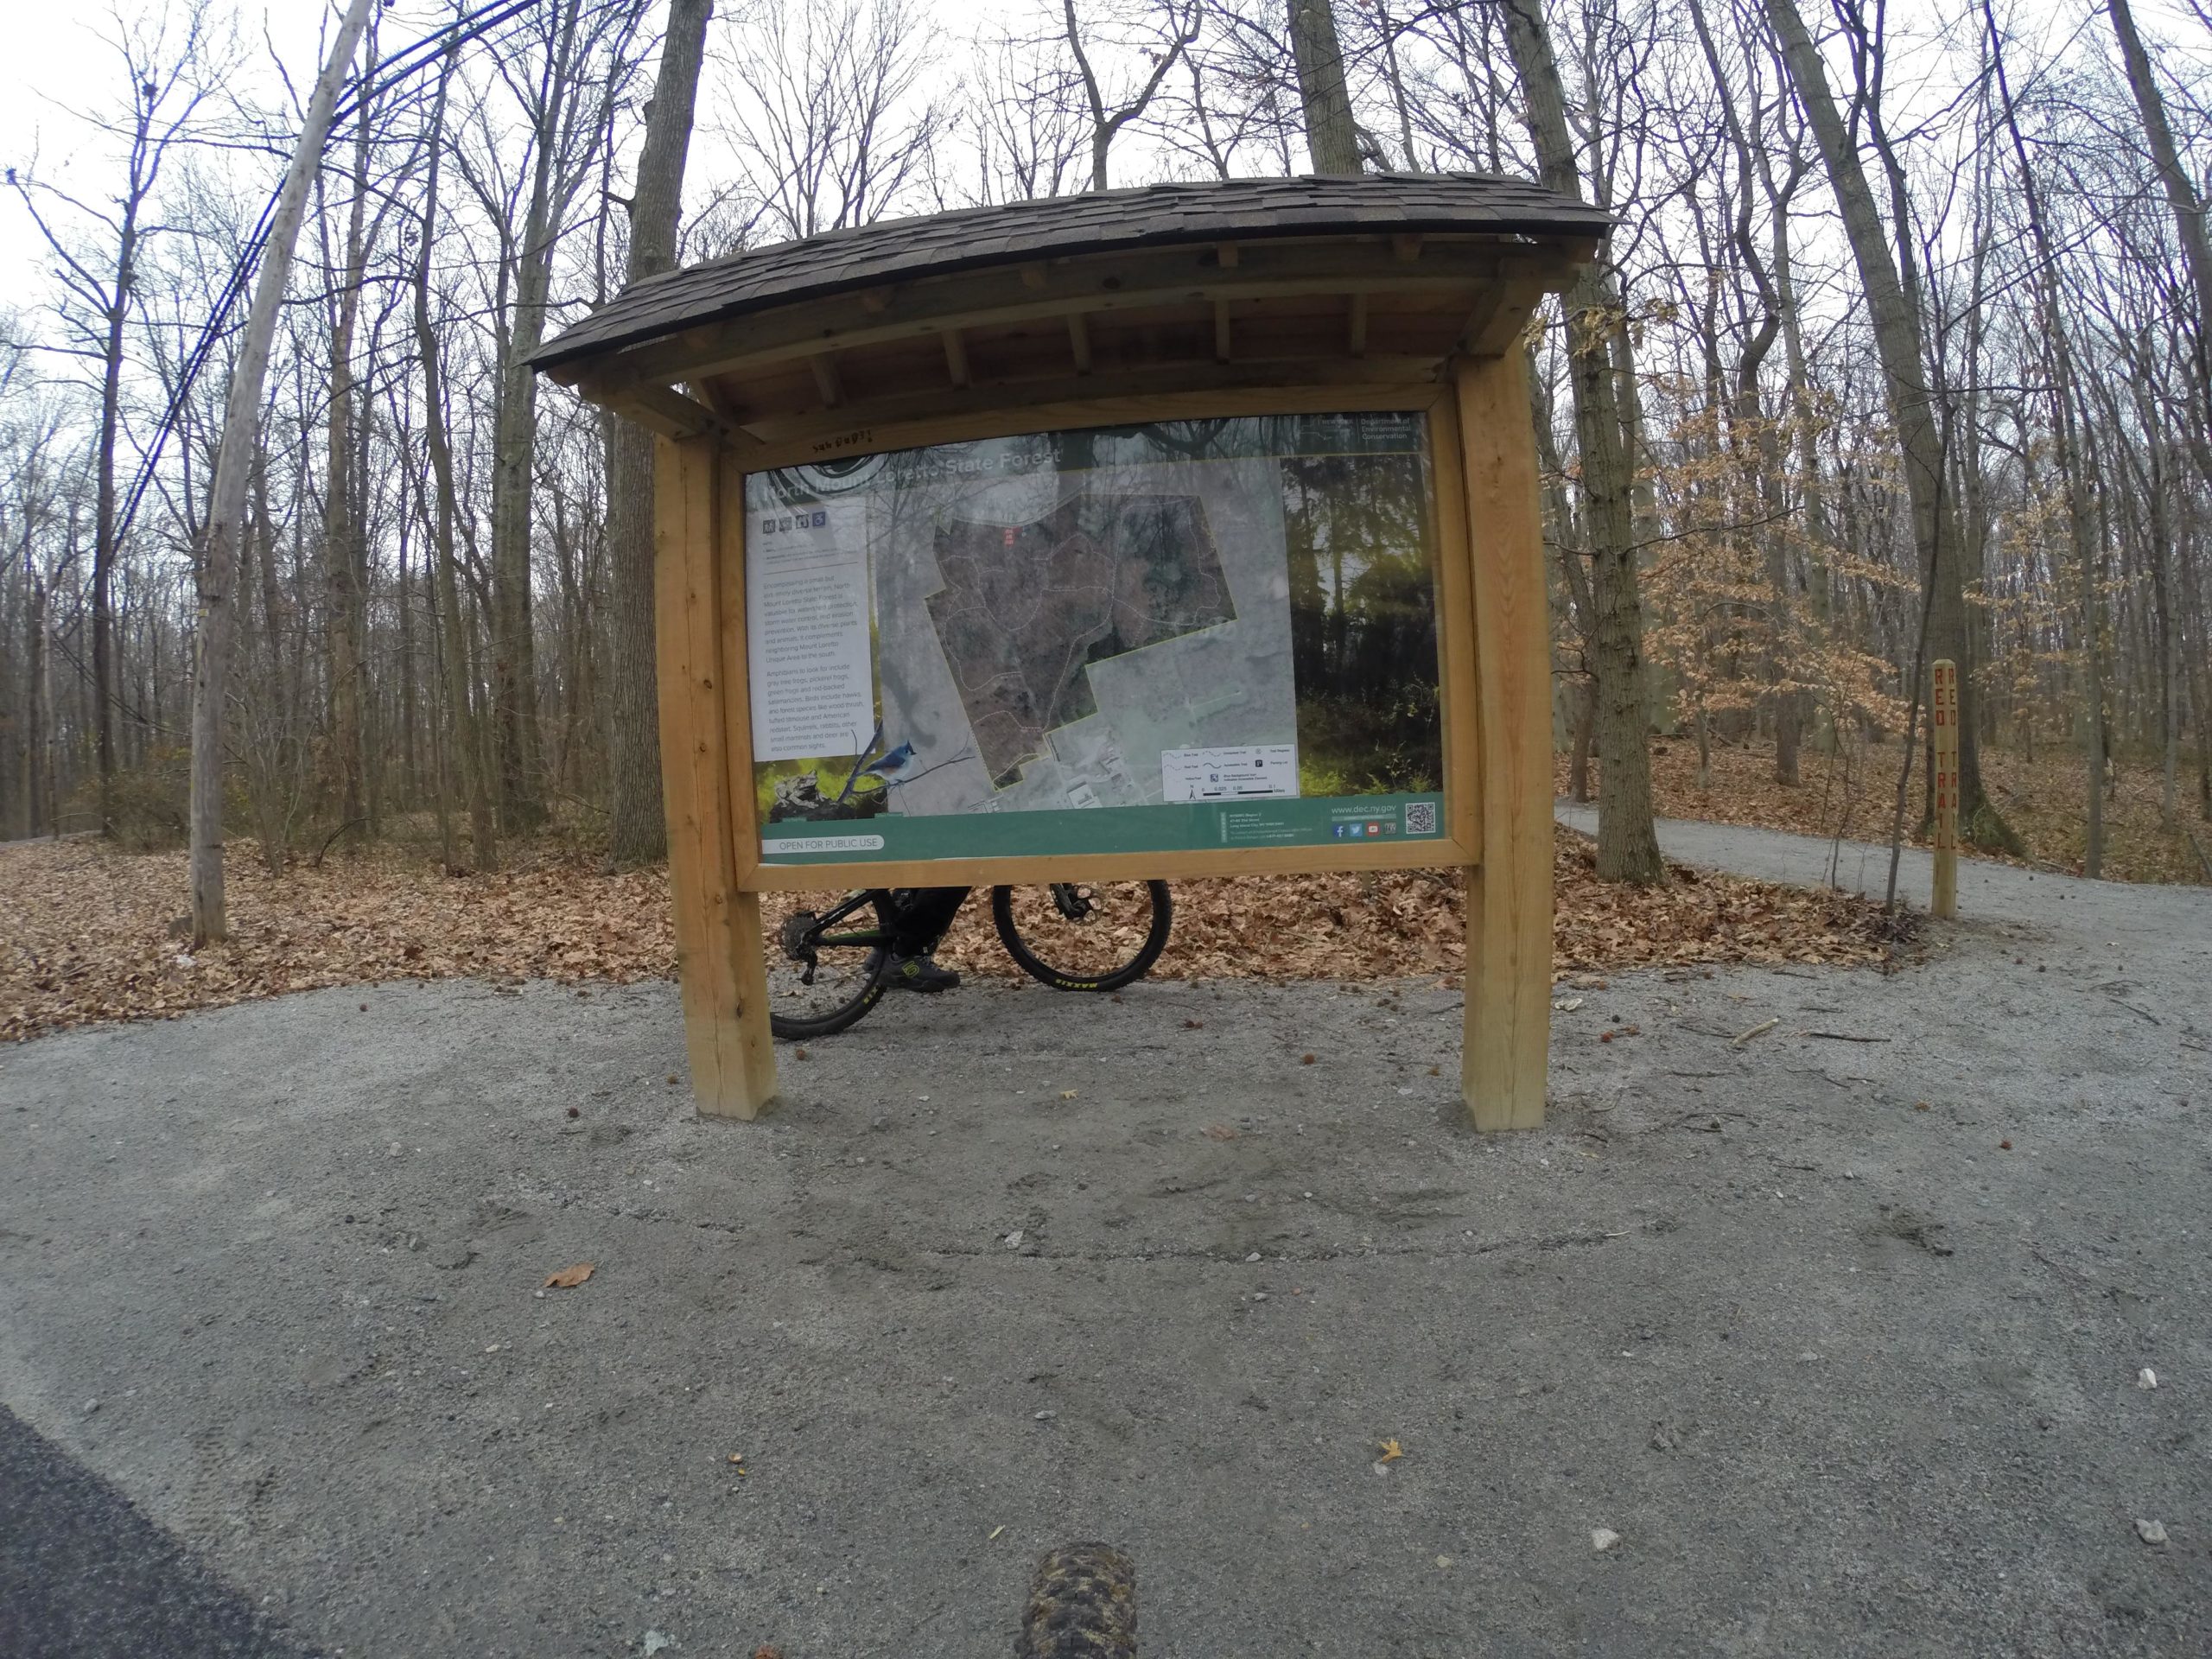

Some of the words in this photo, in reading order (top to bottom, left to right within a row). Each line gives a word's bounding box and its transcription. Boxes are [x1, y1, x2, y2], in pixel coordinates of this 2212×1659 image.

[816, 476, 870, 493] Mount
[946, 457, 994, 473] State
[999, 448, 1061, 468] Forest
[1935, 668, 1945, 727] RED
[1332, 804, 1396, 814] www.dec.ny.gov
[1937, 751, 1947, 849] TRAIL
[779, 842, 803, 850] OPEN
[825, 839, 857, 849] PUBLIC
[860, 838, 877, 847] USE
[1055, 978, 1098, 988] MAXXIS
